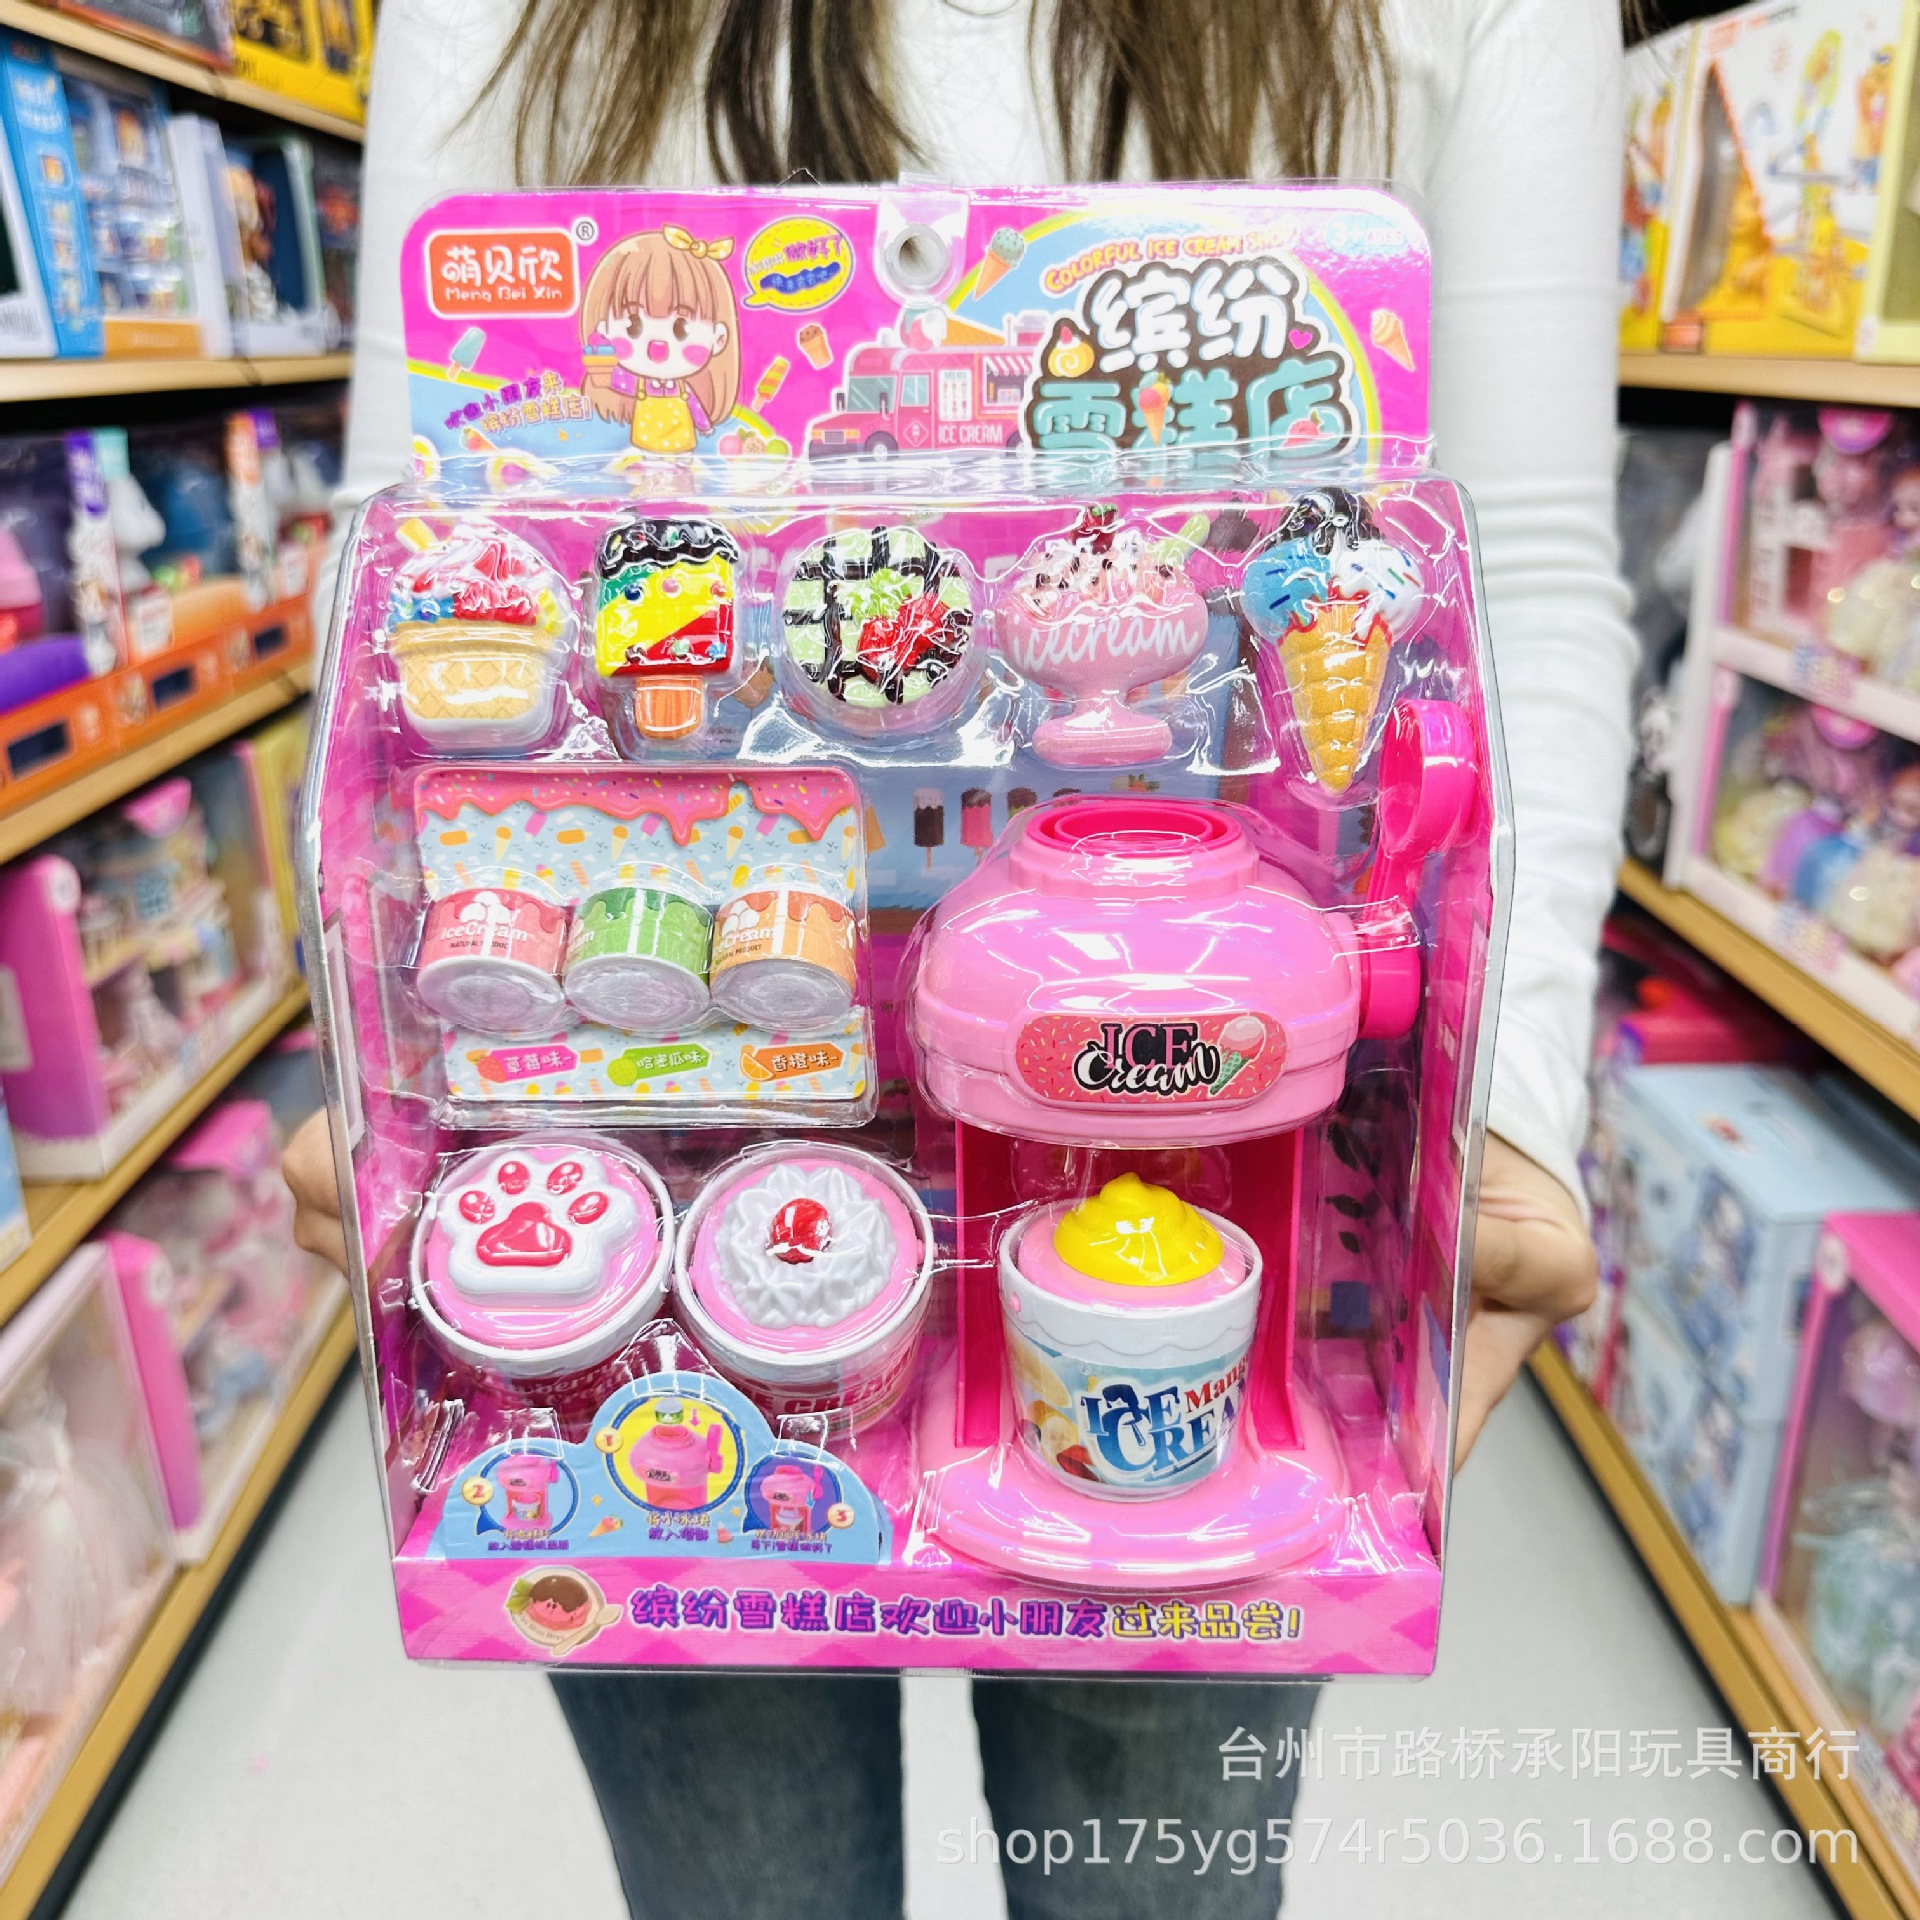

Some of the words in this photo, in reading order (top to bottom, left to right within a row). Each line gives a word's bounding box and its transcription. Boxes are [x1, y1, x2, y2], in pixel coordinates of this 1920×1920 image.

[441, 245, 563, 287] 萌贝欣
[1045, 241, 1142, 293] COLORFUL
[1148, 240, 1180, 259] ICE
[1184, 236, 1244, 257] CREAM
[446, 287, 491, 302] Meng
[498, 286, 527, 300] Bei
[533, 286, 563, 300] Xin
[1092, 264, 1291, 372] 缤纷
[939, 425, 957, 444] ICE
[959, 424, 1003, 444] CREAM
[1033, 358, 1345, 470] 雪糕店
[1013, 614, 1199, 671] icecream
[440, 921, 528, 943] IceCram
[1076, 1045, 1218, 1089] Cream
[1100, 1023, 1198, 1071] ICE
[604, 1434, 614, 1447] 1
[472, 1484, 486, 1499] 2
[836, 1509, 848, 1522] 3
[630, 1584, 1299, 1640] 缤纷雪糕店欢迎小朋友过来品尝!
